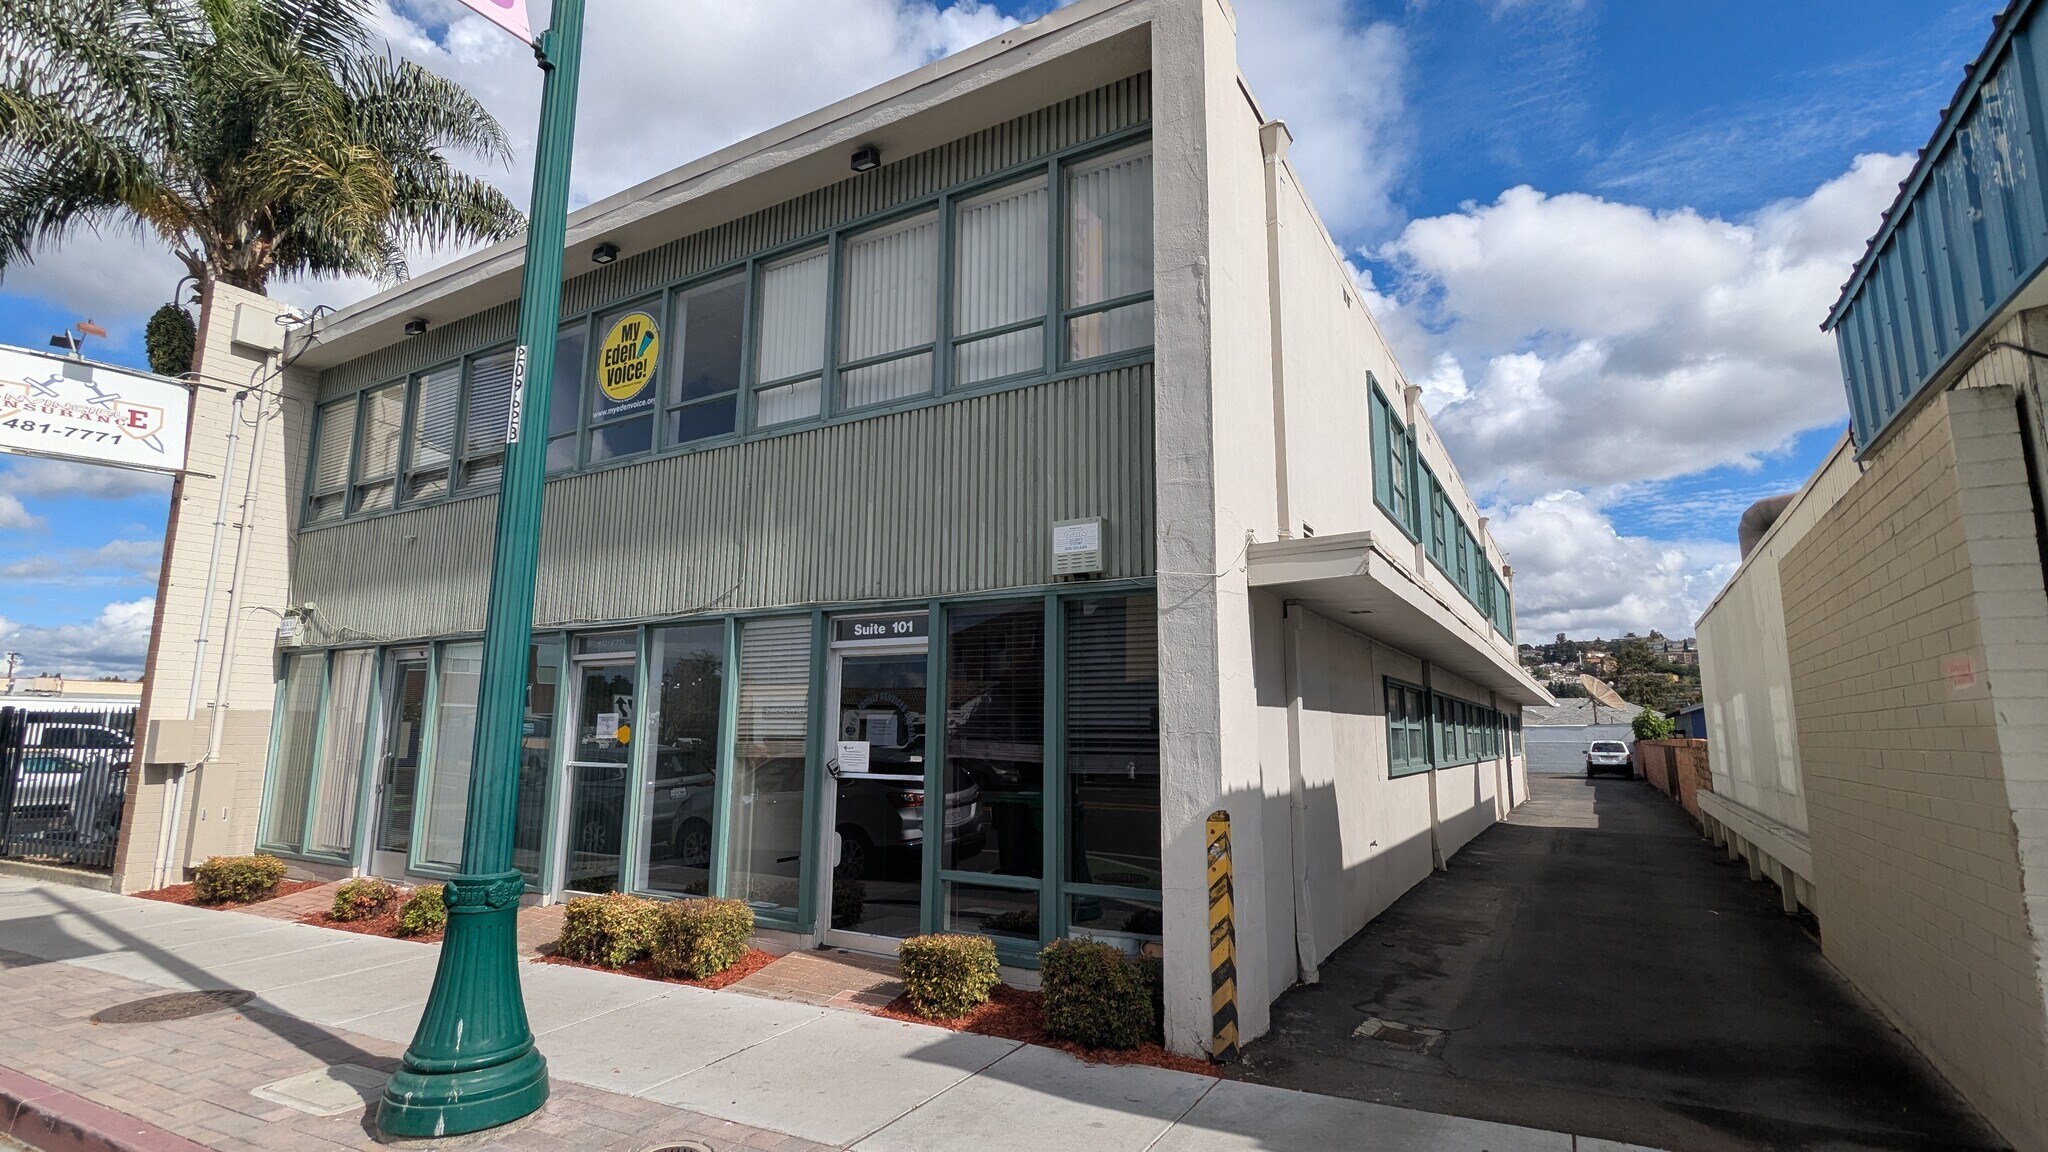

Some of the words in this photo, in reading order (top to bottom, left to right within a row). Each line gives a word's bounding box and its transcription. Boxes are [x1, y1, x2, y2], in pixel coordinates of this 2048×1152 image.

[621, 321, 641, 343] My
[605, 341, 637, 367] Eden
[0, 394, 148, 430] NSURANCE
[593, 397, 657, 418] www.myedenvoice.org
[2, 418, 122, 445] 481-7771
[854, 623, 886, 636] Suite
[892, 620, 913, 633] 101
